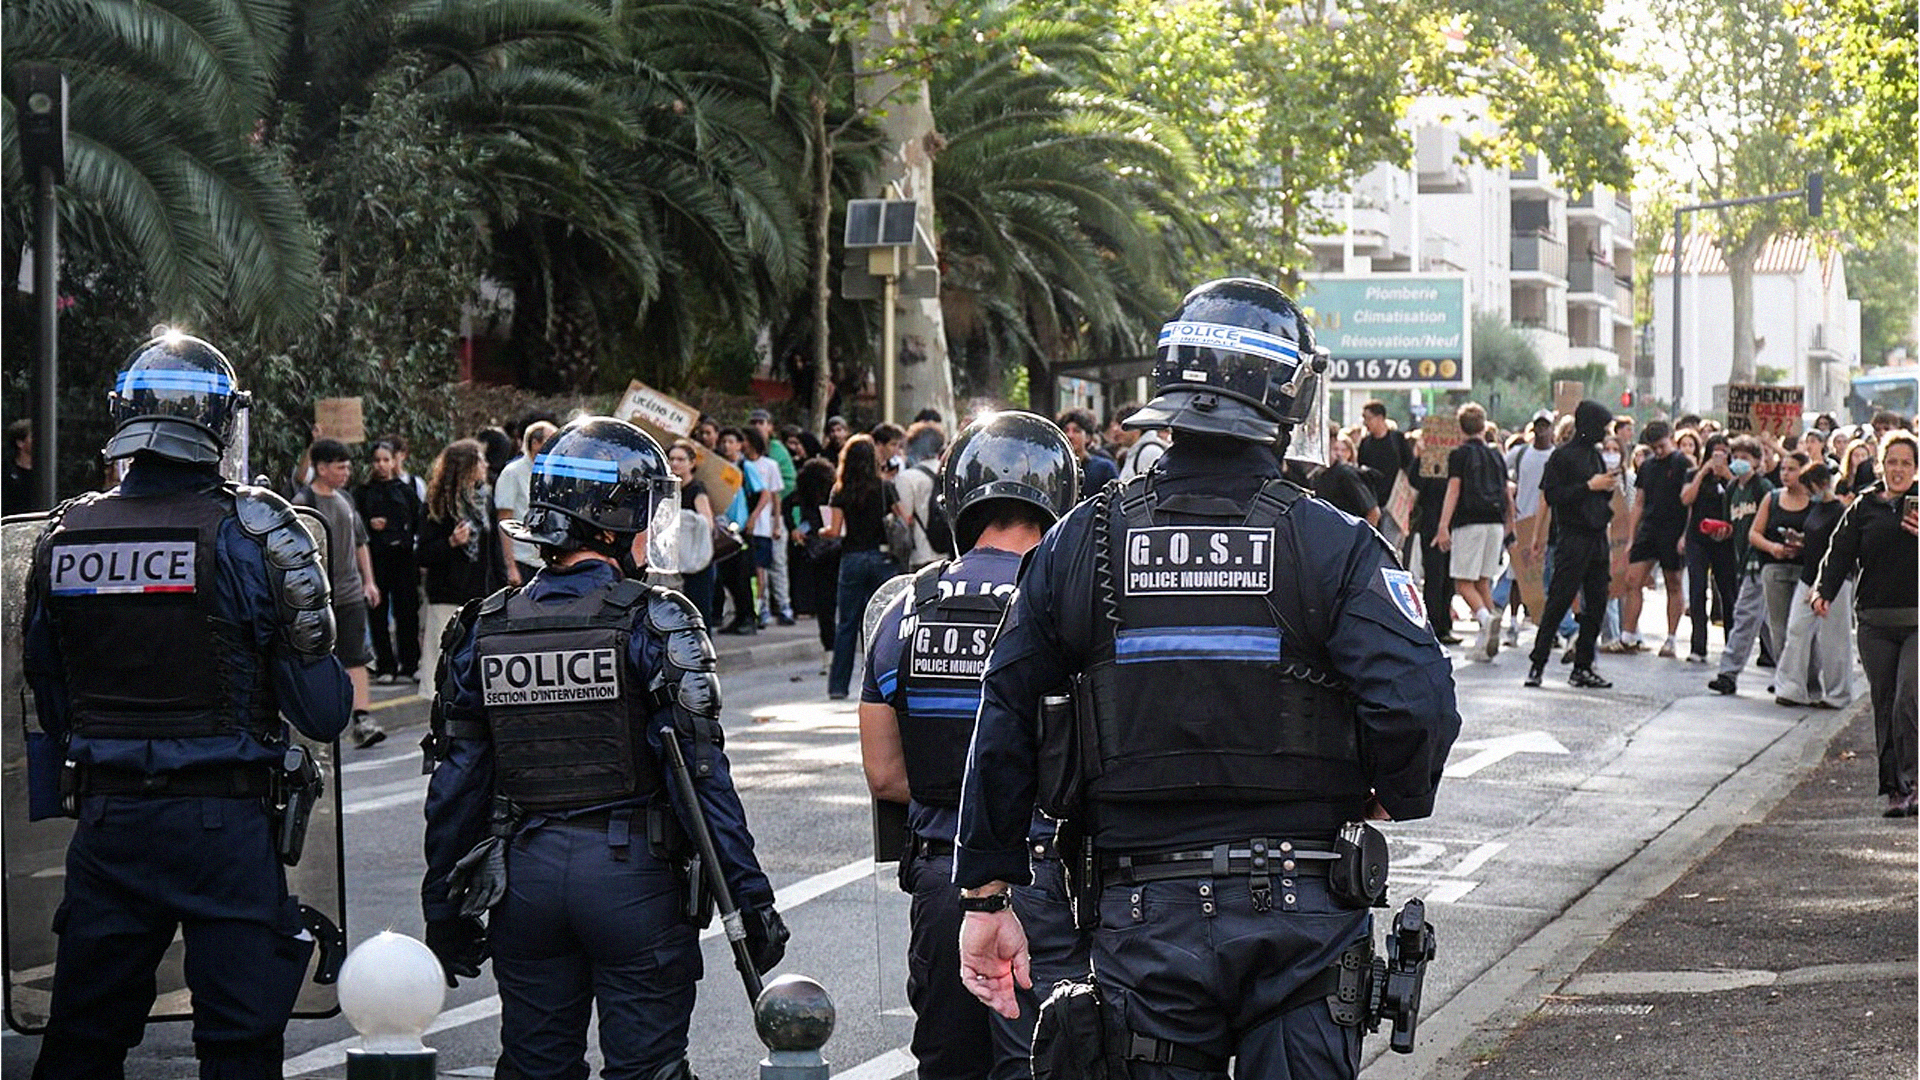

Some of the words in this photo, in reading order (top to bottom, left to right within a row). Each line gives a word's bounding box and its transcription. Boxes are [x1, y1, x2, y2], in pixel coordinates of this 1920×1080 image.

[1365, 286, 1438, 300] Plomberie
[1353, 309, 1447, 324] Climatisation
[1171, 325, 1239, 341] POLICE
[1340, 333, 1460, 349] Rénovation/Neuf
[1355, 359, 1381, 379] 16
[1385, 359, 1412, 379] 76
[668, 411, 684, 423] EN
[1130, 532, 1268, 566] G.O.S.T
[55, 551, 189, 583] POLICE
[1130, 571, 1178, 589] POLICE
[1181, 571, 1267, 588] MUNICIPALE
[484, 651, 615, 689] POLICE
[914, 658, 948, 673] POLICE
[486, 691, 526, 704] SECTION
[531, 686, 615, 701] D'INTERVENTION
